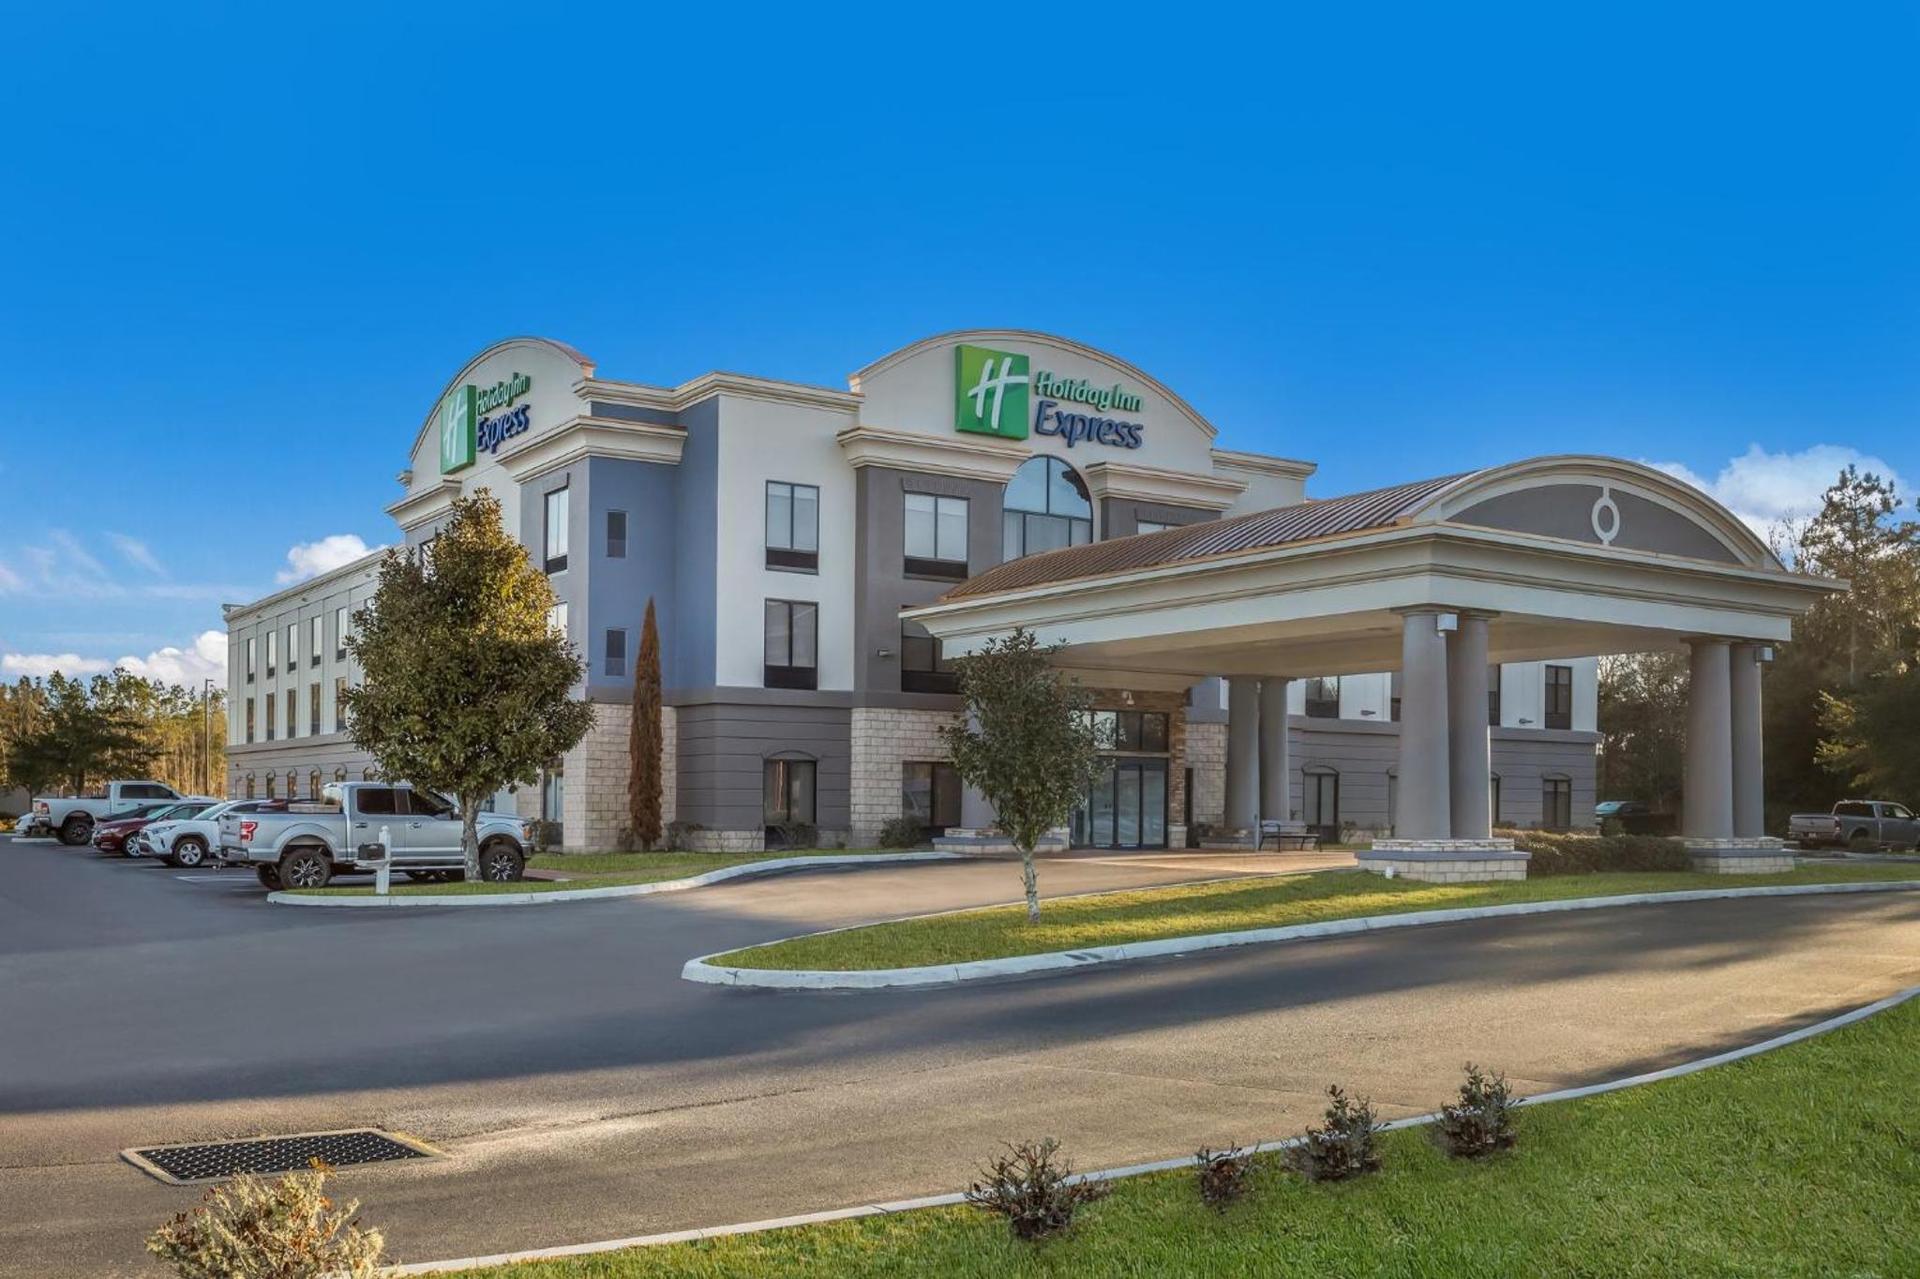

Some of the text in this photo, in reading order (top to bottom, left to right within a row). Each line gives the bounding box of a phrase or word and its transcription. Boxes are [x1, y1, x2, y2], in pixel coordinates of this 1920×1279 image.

[476, 372, 531, 415] Holiday Inn
[968, 357, 1028, 429] H
[1035, 371, 1142, 412] Holiday Inn
[443, 393, 468, 463] H
[476, 404, 530, 454] Express
[1035, 400, 1143, 449] Express
